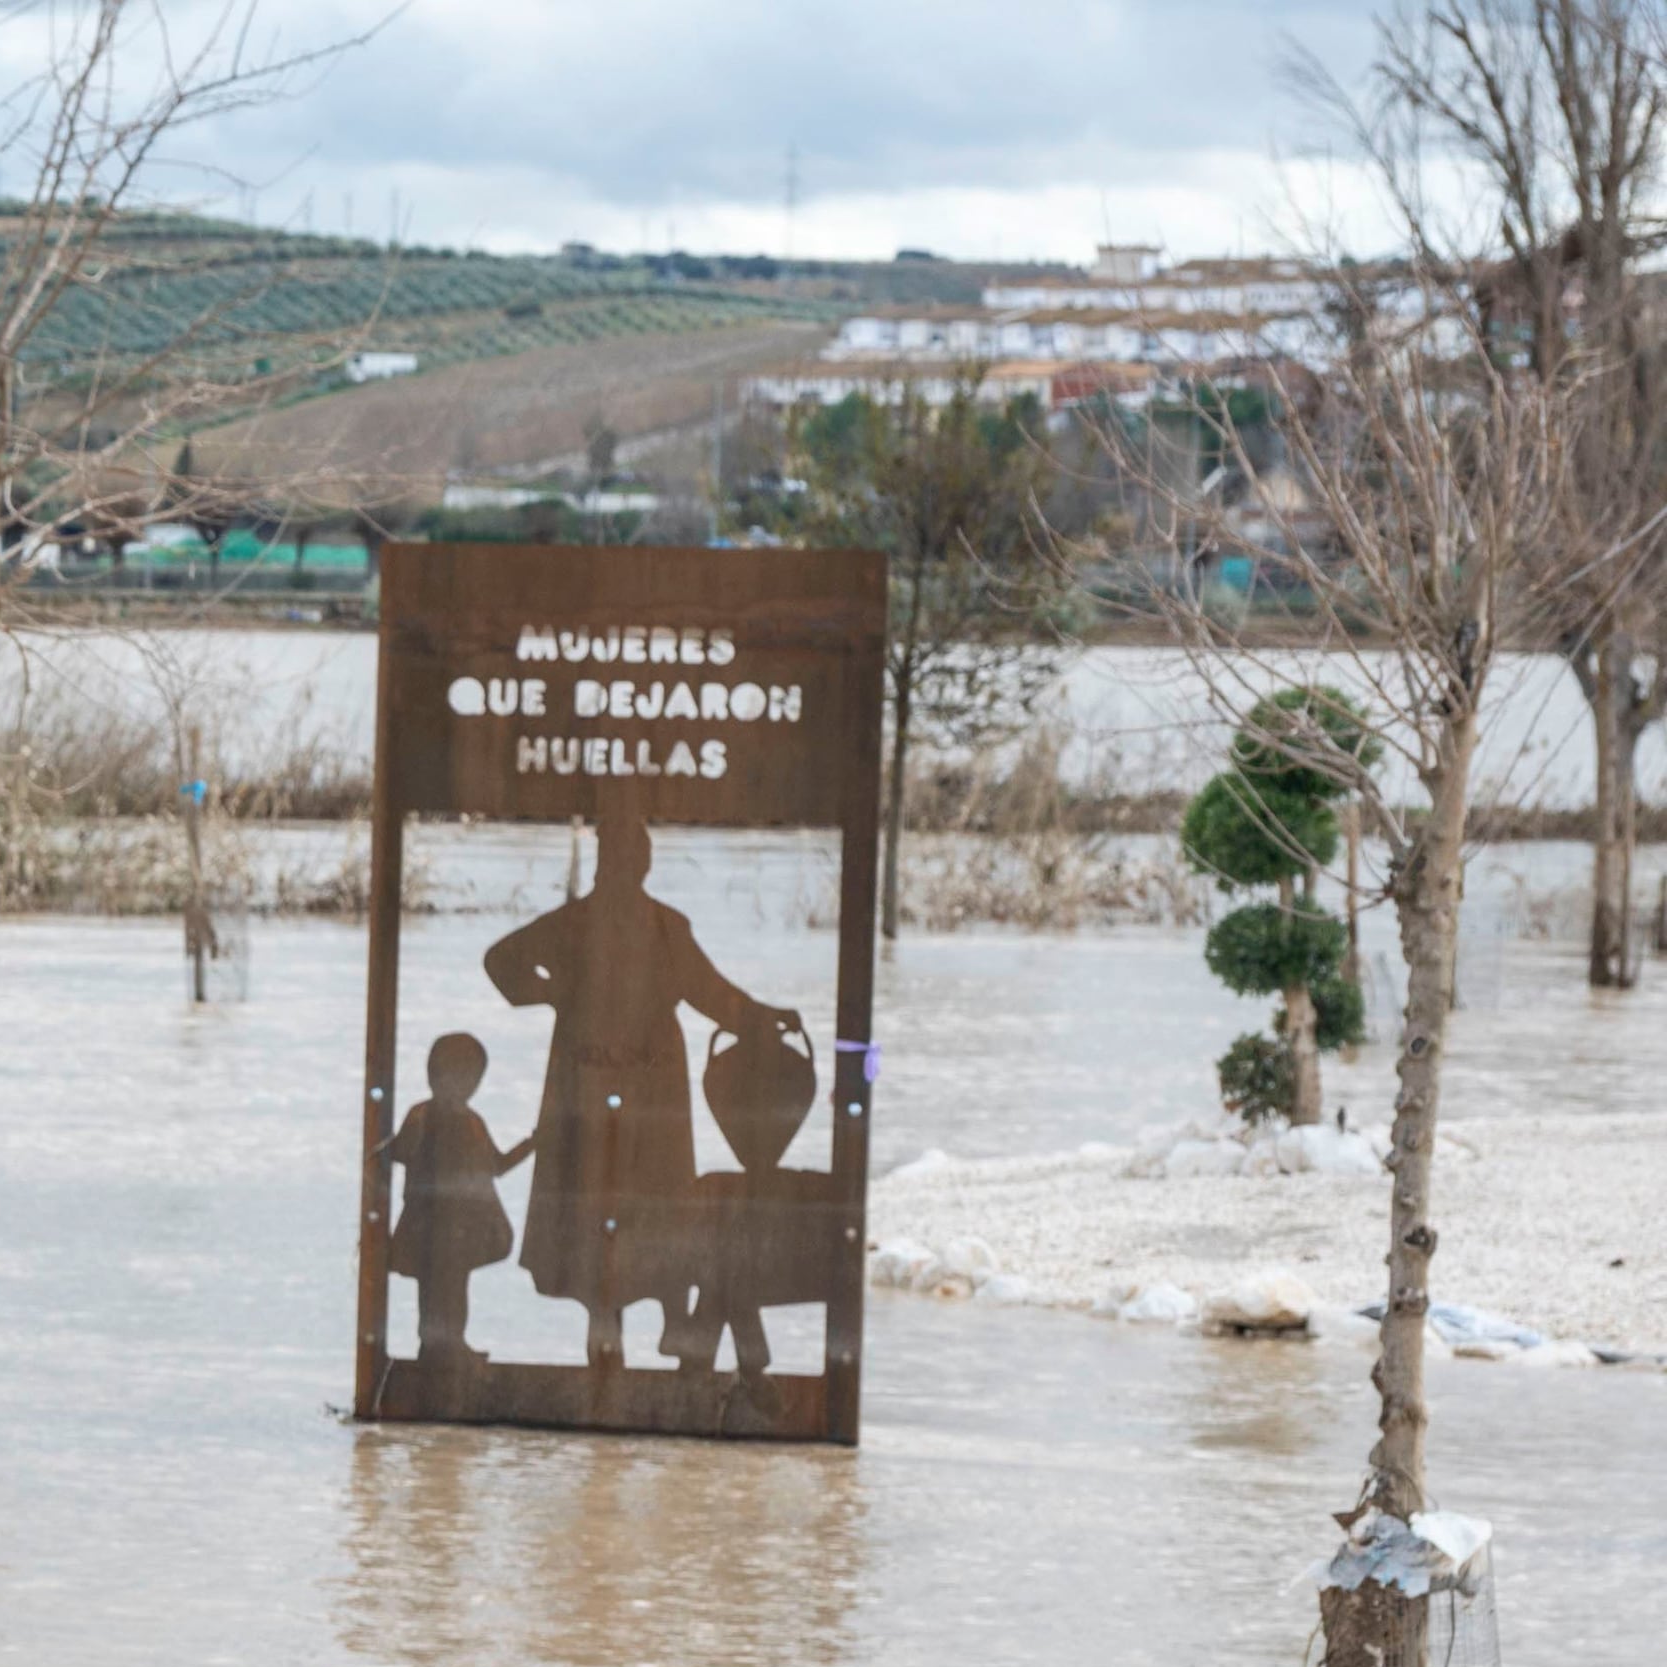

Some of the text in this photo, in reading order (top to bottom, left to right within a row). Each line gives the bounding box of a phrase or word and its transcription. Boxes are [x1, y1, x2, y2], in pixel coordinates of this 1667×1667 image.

[517, 624, 736, 666] MUJERES
[448, 676, 802, 722] QUE DEJARON
[517, 736, 728, 779] HUELLAS
